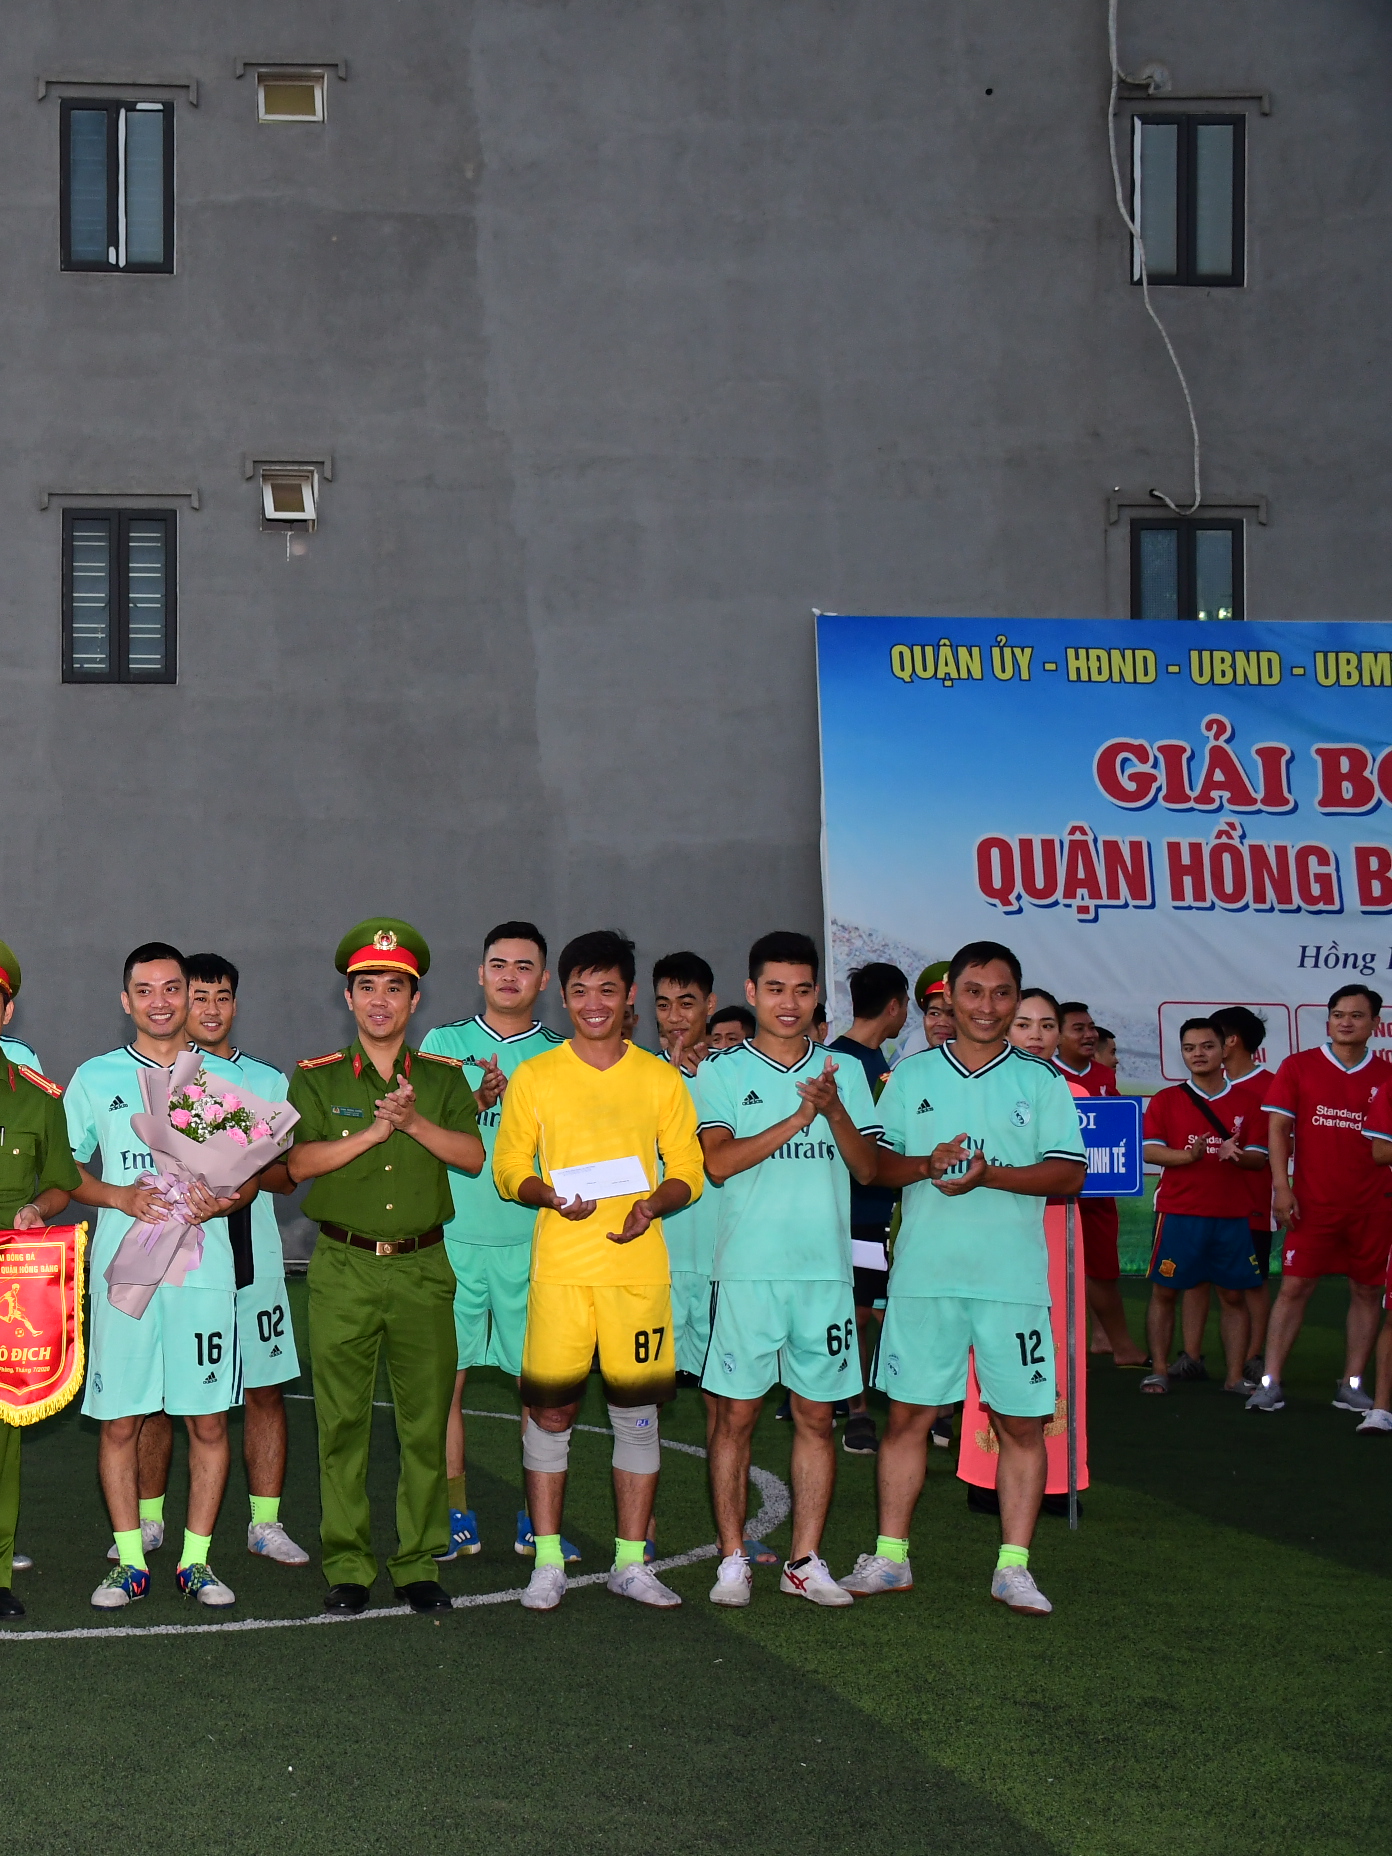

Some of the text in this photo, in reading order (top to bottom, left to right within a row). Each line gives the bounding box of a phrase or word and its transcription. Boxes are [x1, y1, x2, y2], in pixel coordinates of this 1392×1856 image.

[890, 637, 983, 688] QUẬN
[989, 634, 1033, 681] ỦY
[1065, 647, 1157, 684] HĐND
[1189, 649, 1282, 686] UBND
[1314, 650, 1392, 687] UBM
[1095, 715, 1298, 811] GIẢI
[974, 822, 1152, 921] QUẬN
[1163, 819, 1340, 912] HỒNG
[1297, 940, 1376, 976] Hồng
[1311, 1115, 1362, 1131] Chartered
[1315, 1104, 1363, 1121] Standard
[1112, 1138, 1127, 1174] TẾ
[257, 1304, 285, 1342] 02
[11, 1346, 52, 1364] ĐỊCH
[194, 1331, 222, 1366] 16
[634, 1326, 665, 1364] 87
[1015, 1329, 1046, 1367] 12
